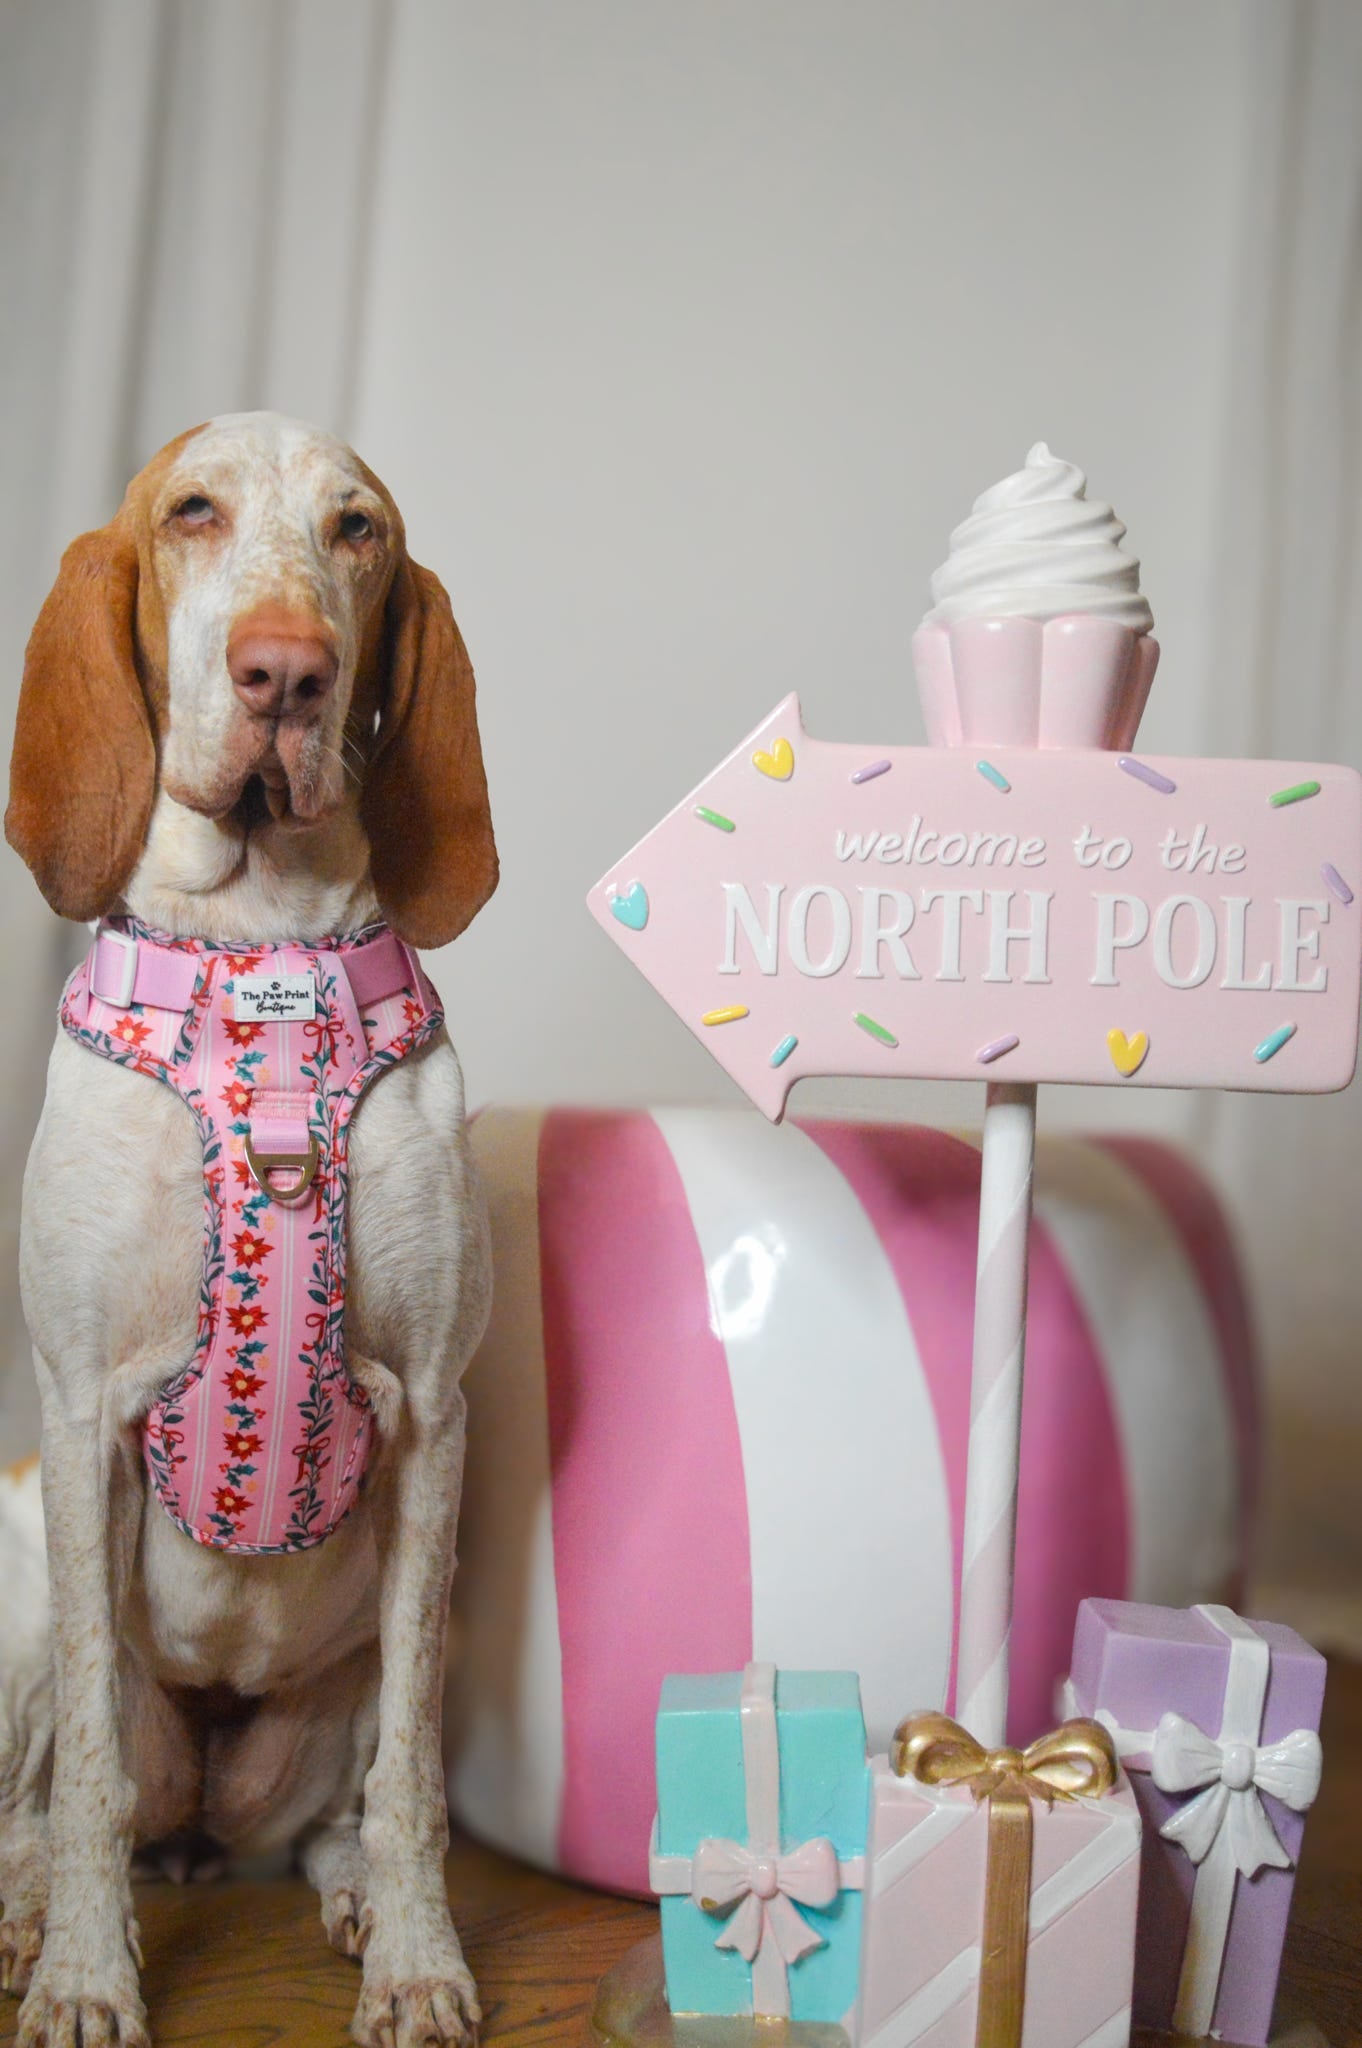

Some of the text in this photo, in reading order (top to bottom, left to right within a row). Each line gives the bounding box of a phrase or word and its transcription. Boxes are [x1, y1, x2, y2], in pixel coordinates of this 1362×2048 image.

[834, 814, 1247, 874] welcome to the
[717, 881, 1333, 993] NORTH POLE
[241, 989, 310, 1001] The Paw Print
[256, 1000, 296, 1015] Boutique
